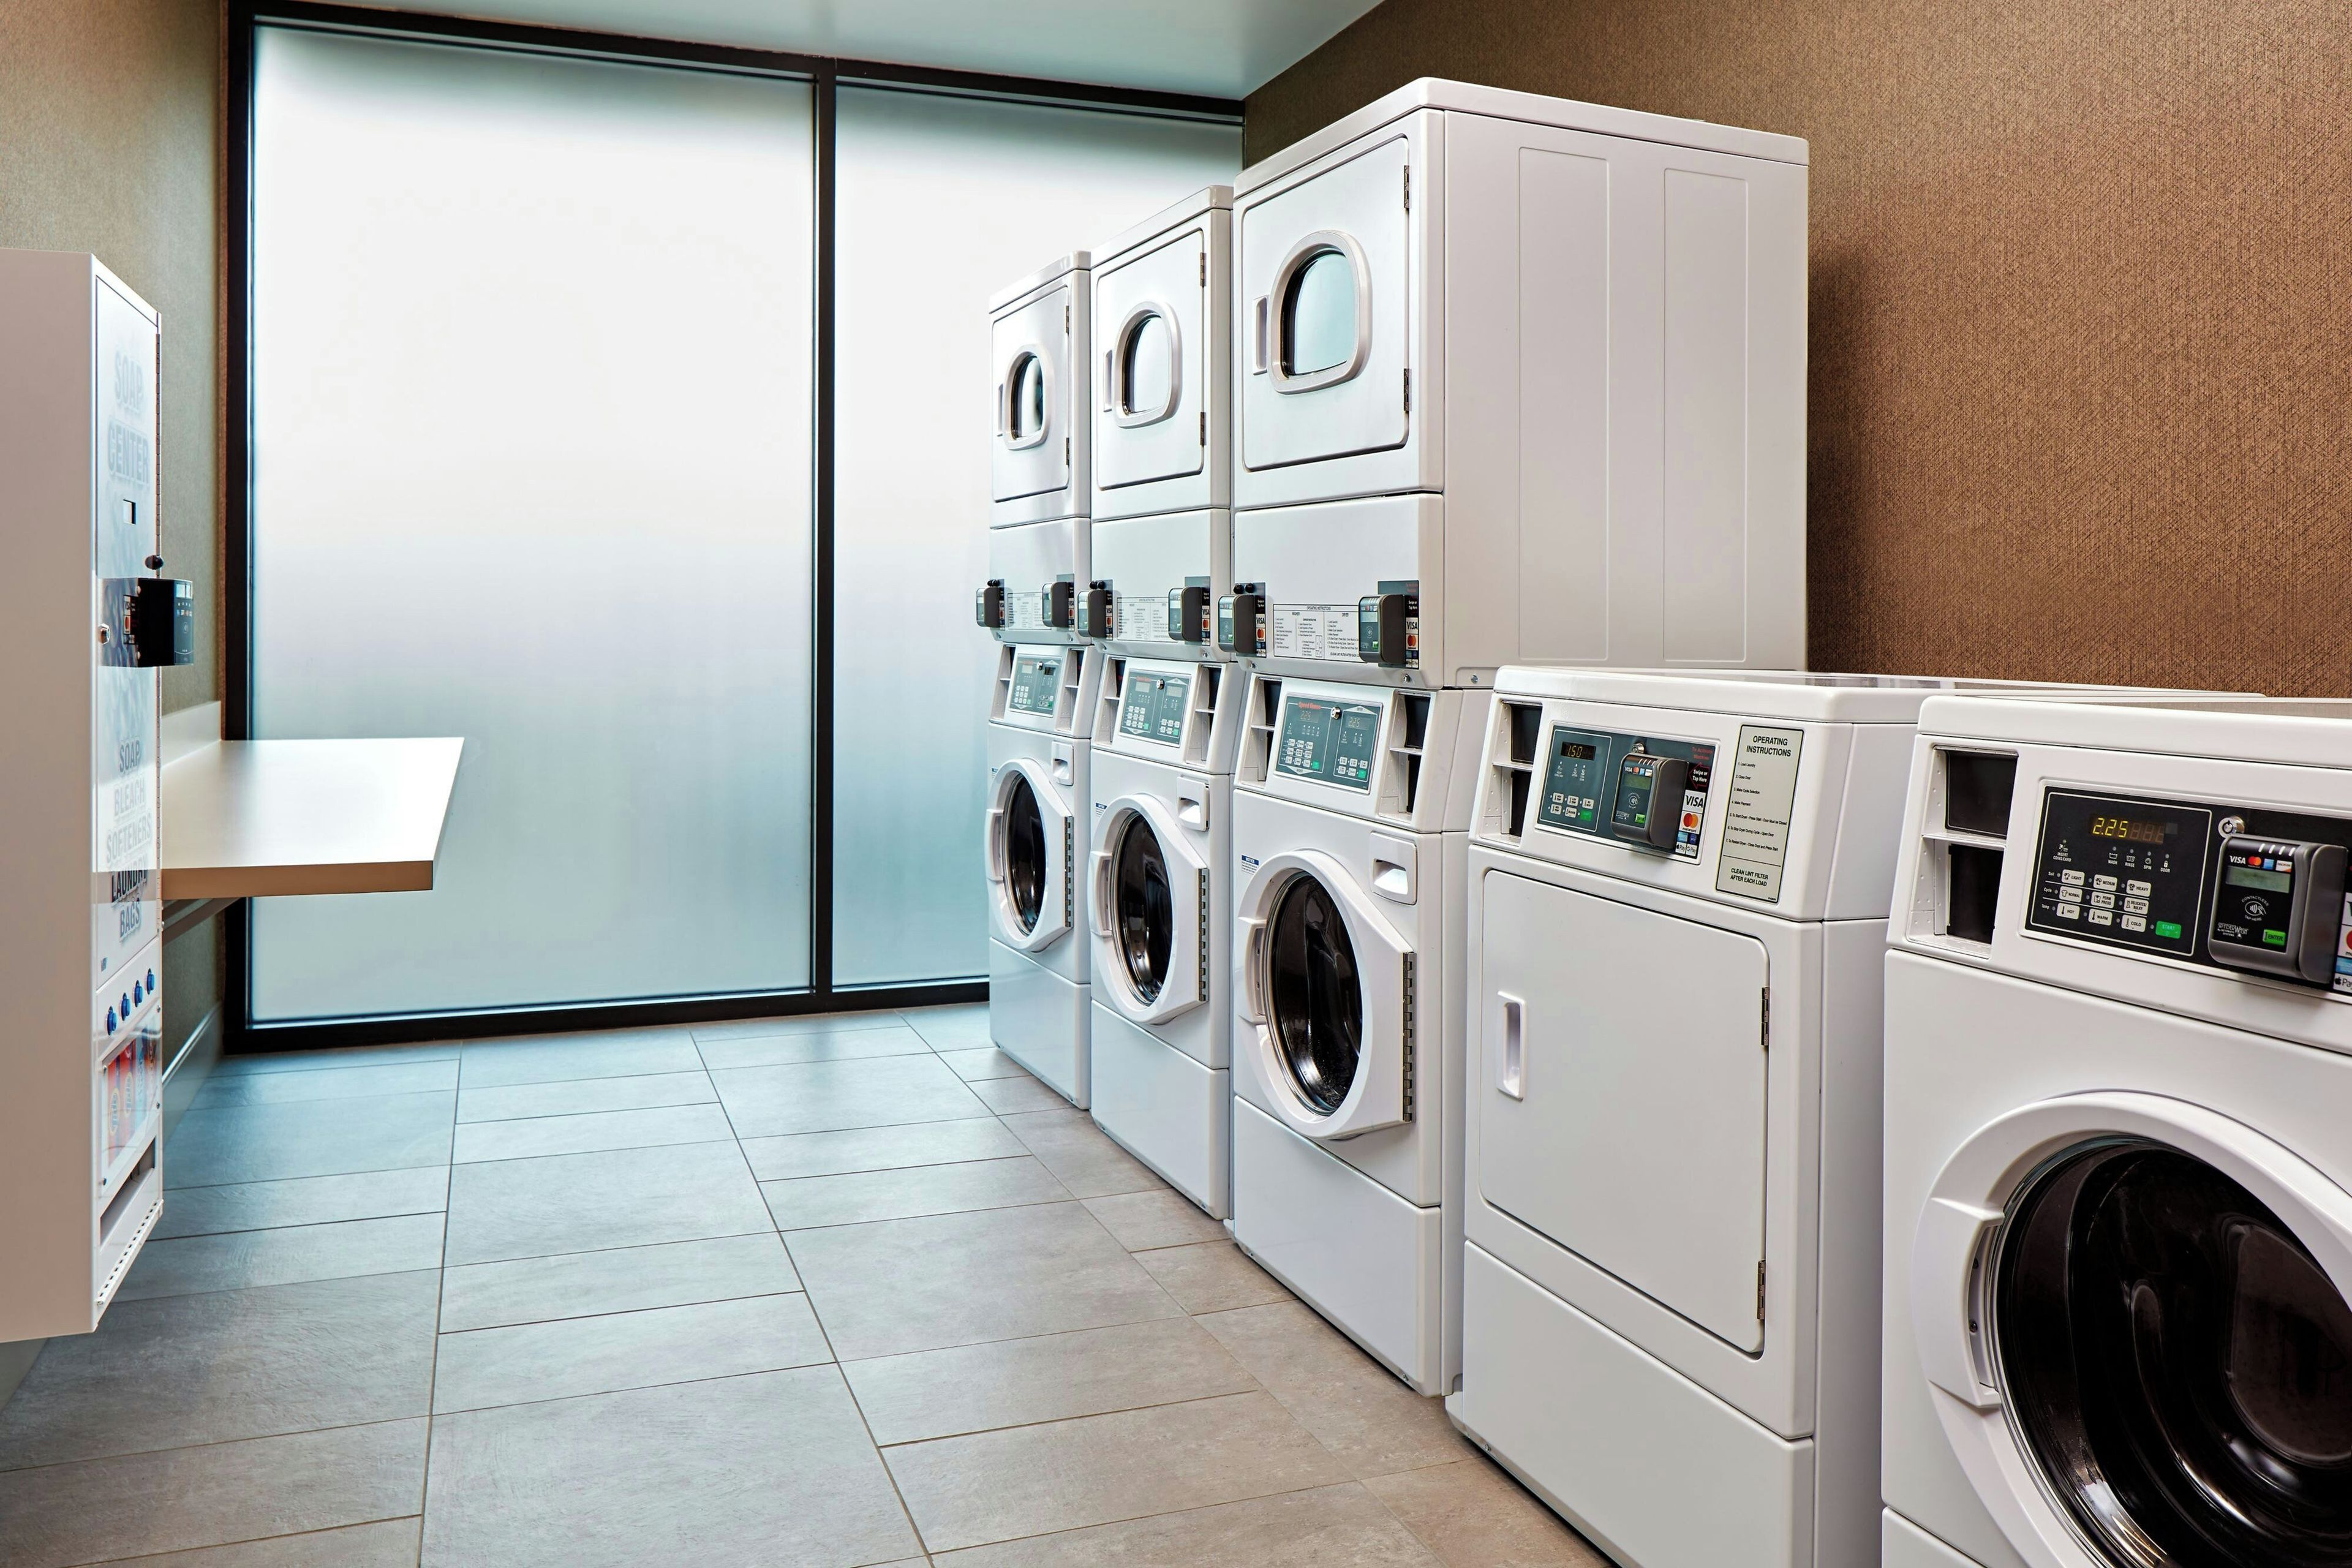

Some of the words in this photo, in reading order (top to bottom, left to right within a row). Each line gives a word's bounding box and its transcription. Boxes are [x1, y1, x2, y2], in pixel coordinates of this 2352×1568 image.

[115, 350, 144, 409] SOAP
[108, 421, 149, 484] CENTER
[1407, 621, 1418, 630] VISA
[1747, 745, 1791, 757] INSTRUCTIONS
[1753, 736, 1788, 745] OPERATING
[119, 739, 140, 773] SOAP
[114, 778, 145, 817] BLEACH
[1686, 795, 1703, 808] VISA
[2092, 817, 2128, 838] 2.25
[107, 813, 151, 864] SOFTENERS
[2230, 855, 2246, 865] VISA
[111, 853, 147, 903] LAUNDRY
[2242, 895, 2269, 906] CONTACTLESS
[120, 897, 140, 938] BAGS
[2342, 978, 2352, 990] Pa
